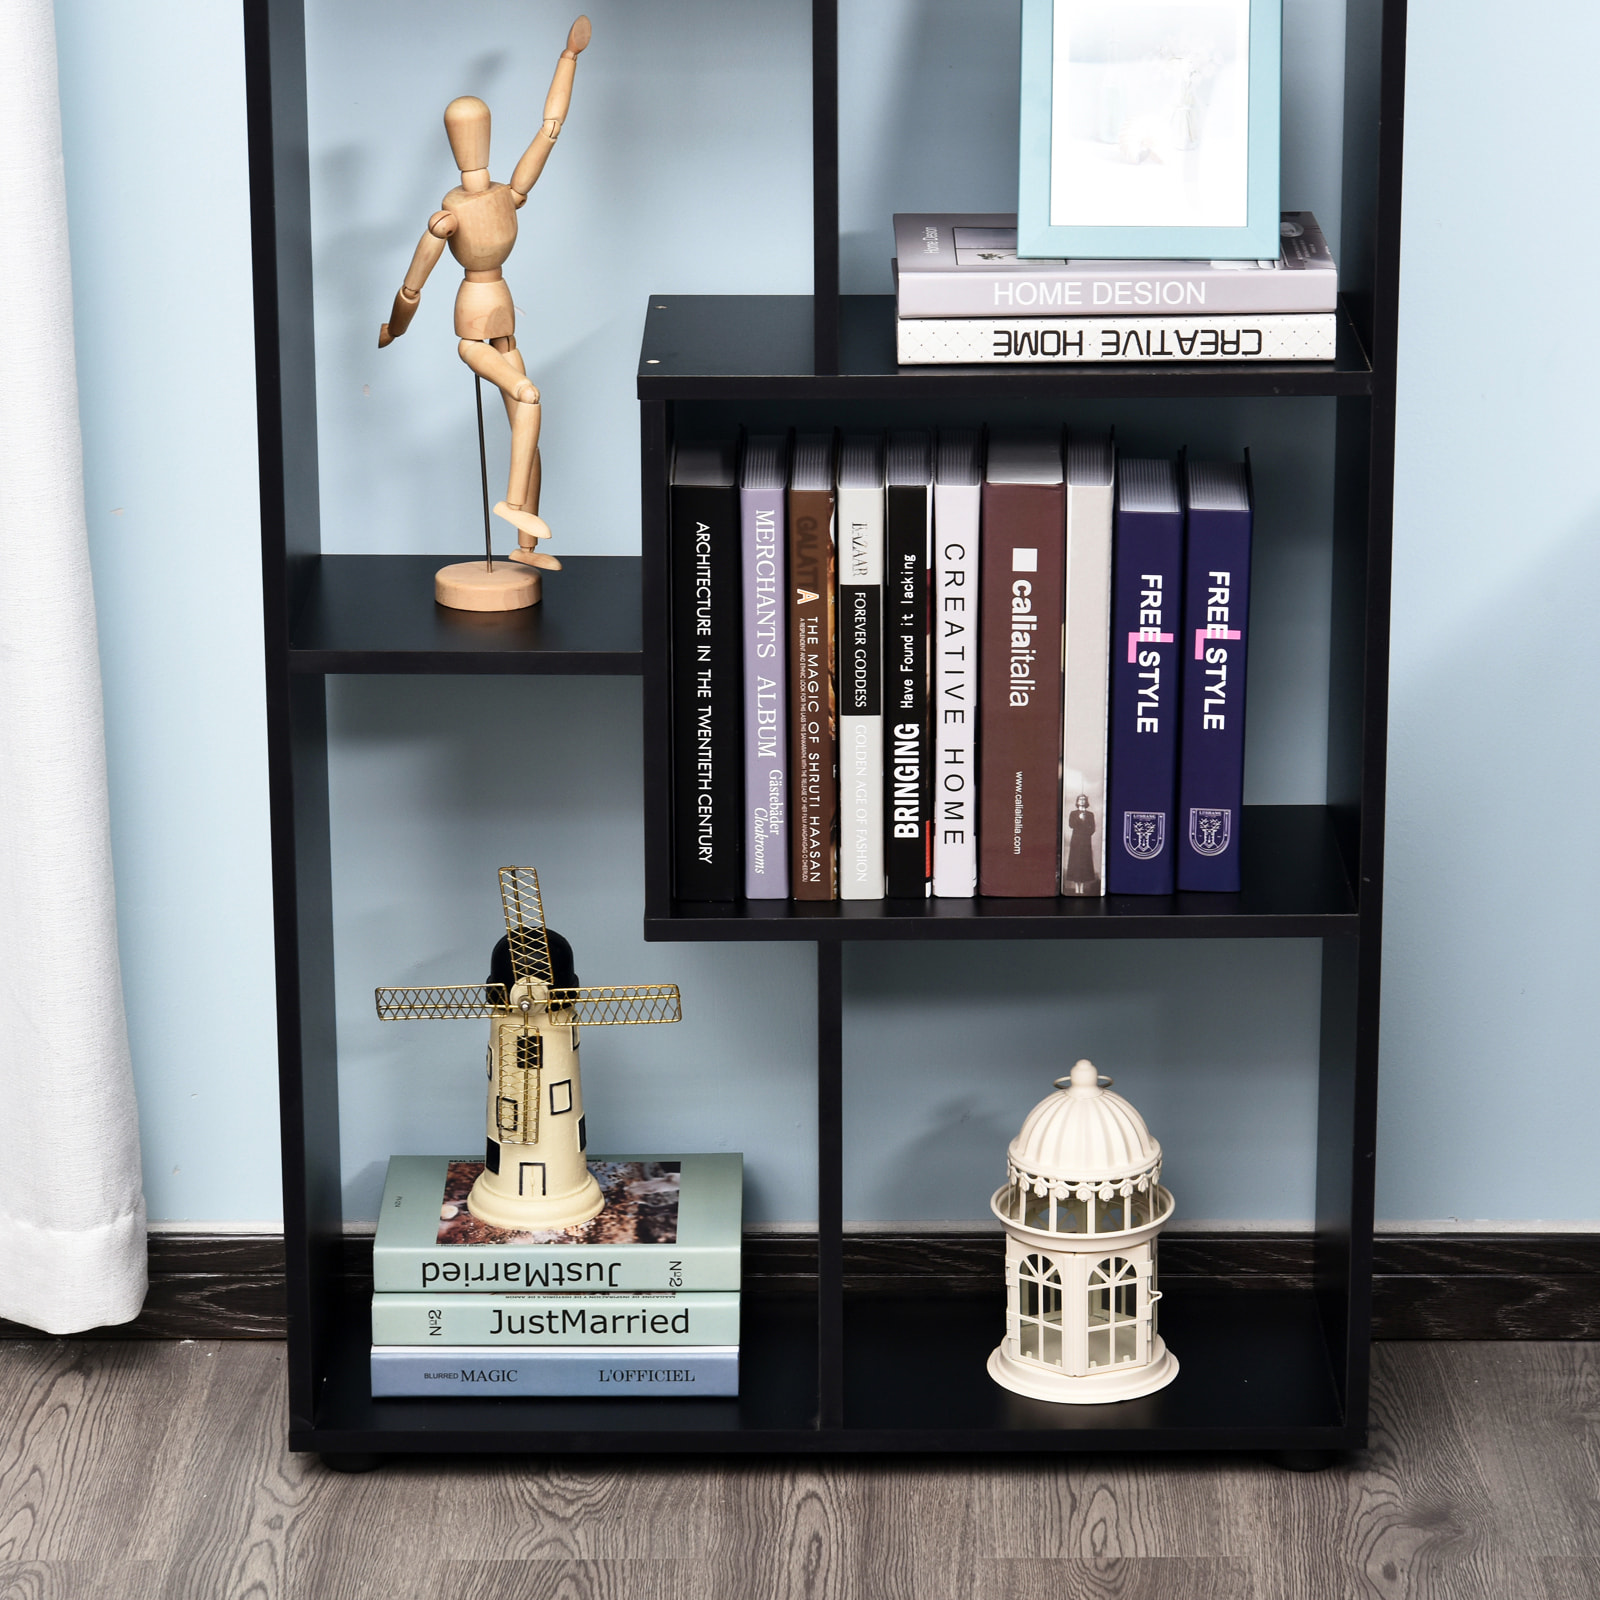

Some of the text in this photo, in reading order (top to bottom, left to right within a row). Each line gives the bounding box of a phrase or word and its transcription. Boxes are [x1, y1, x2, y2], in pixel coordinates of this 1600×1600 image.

[993, 281, 1207, 307] HOME DESION
[993, 329, 1263, 357] CREATIVE HOME
[851, 521, 867, 577] BAZAAR
[755, 509, 777, 759] MERCHANTS ALBUM
[854, 591, 867, 708] FOREVER GODDESS
[1009, 579, 1038, 708] caliaitalia
[1137, 574, 1163, 734] FREE STYLE
[1203, 571, 1231, 730] FREE STYLE
[695, 521, 713, 865] ARCHITECTURE IN THE TWENTIETH CENTURY
[893, 554, 920, 839] BRINGING Have Found it lacking
[944, 542, 966, 846] CREATIVE HOME
[807, 616, 822, 883] THE MAGIC OF SHRUTI HAASAN
[753, 806, 769, 875] Cloakrooms
[768, 768, 784, 836] Gästebäder
[855, 724, 868, 883] GOLDEN AGE OF FASHION
[1013, 770, 1024, 856] www.caliaitalia.com
[422, 1261, 622, 1288] JustMarried
[489, 1308, 690, 1335] JustMarried
[423, 1369, 519, 1383] BLURRED MAGIC
[598, 1369, 696, 1383] L'OFFICIEL
